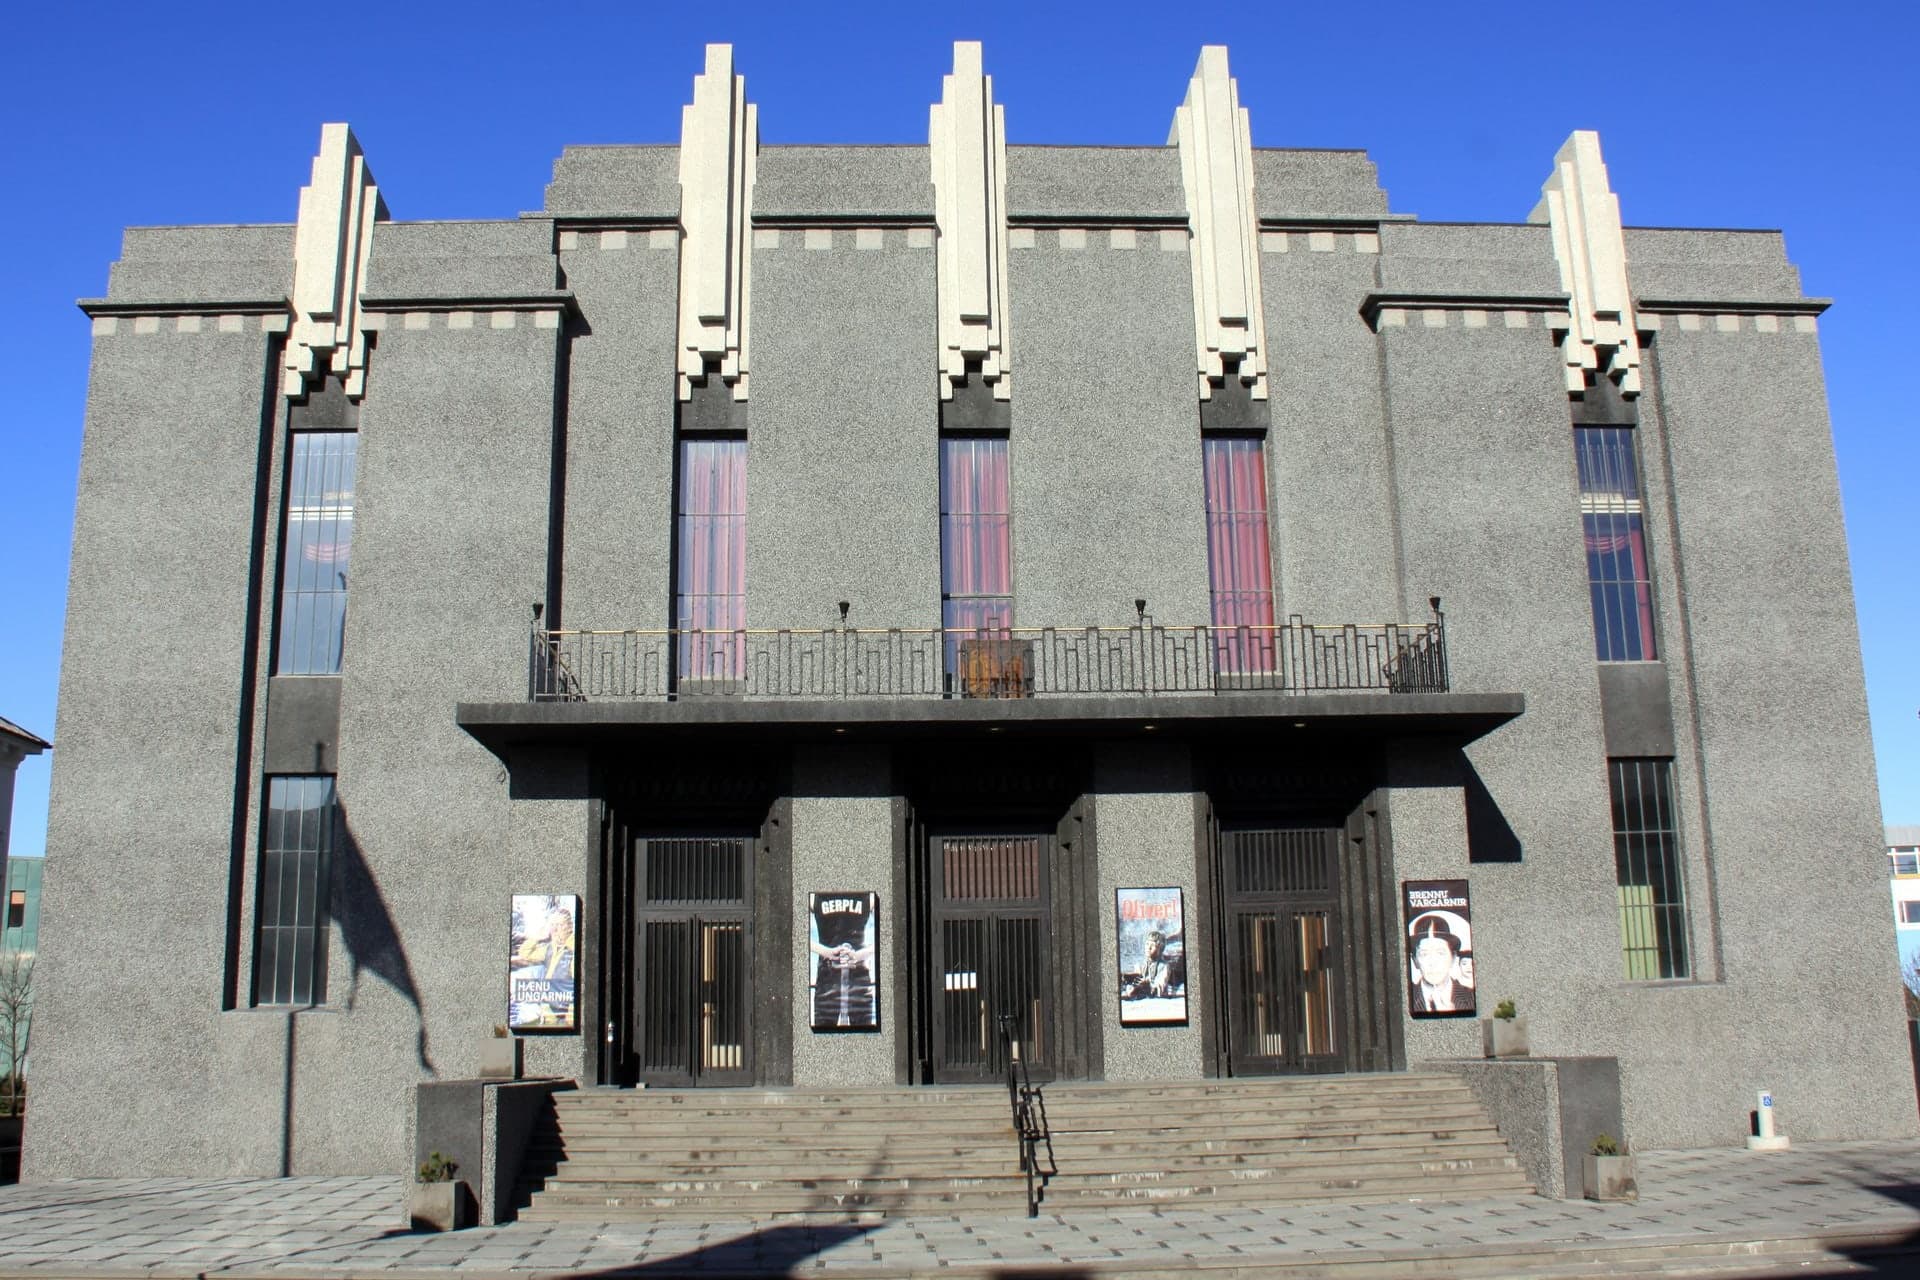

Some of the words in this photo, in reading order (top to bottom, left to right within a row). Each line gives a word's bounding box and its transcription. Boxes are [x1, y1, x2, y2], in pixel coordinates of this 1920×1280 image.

[1409, 890, 1449, 899] BRENNU
[821, 899, 862, 914] GERPLA
[1122, 897, 1177, 920] Oliver!
[1409, 898, 1467, 908] VARGARNIR
[518, 981, 551, 992] HÆNU
